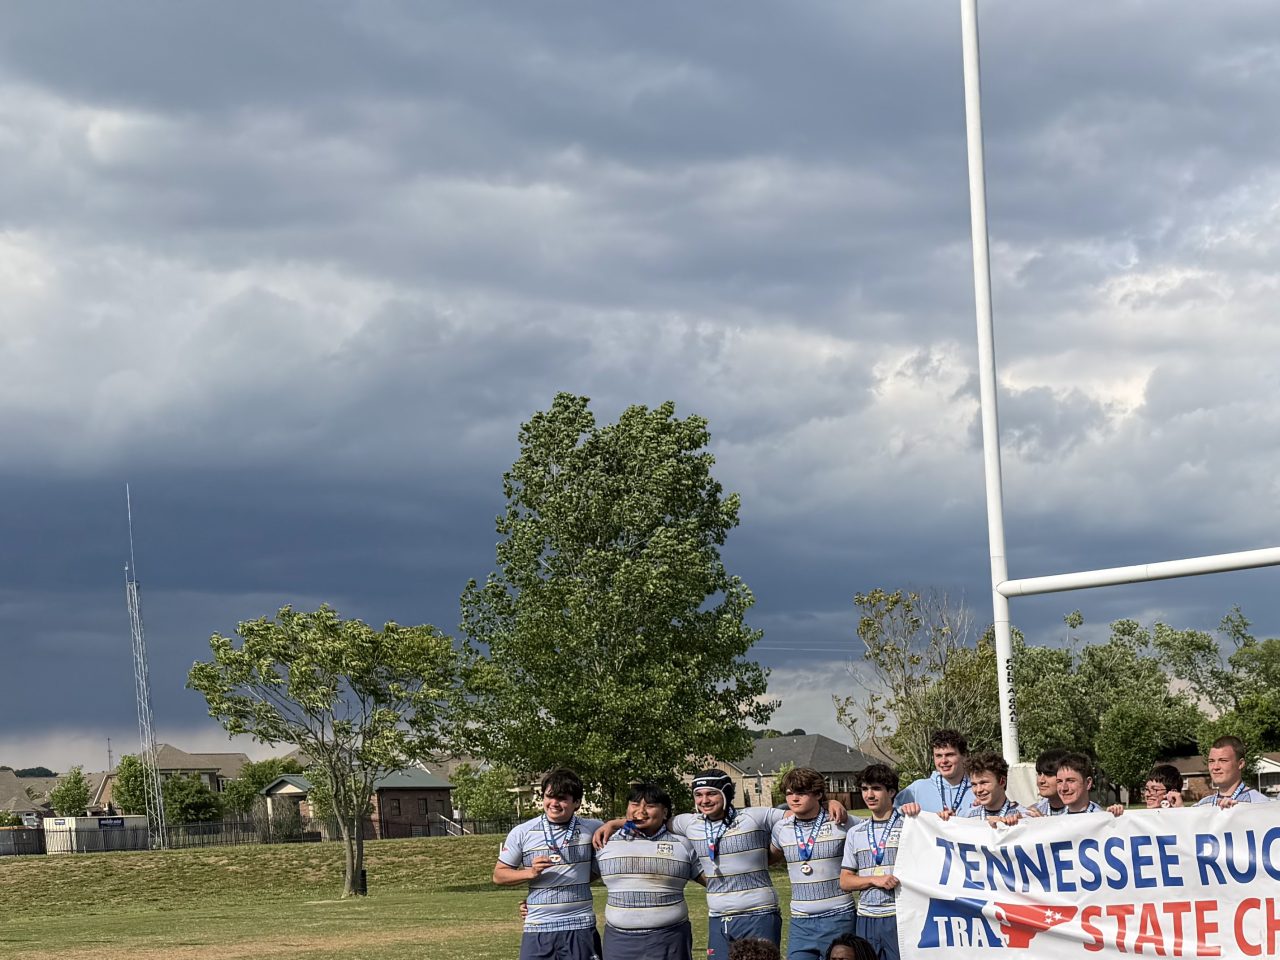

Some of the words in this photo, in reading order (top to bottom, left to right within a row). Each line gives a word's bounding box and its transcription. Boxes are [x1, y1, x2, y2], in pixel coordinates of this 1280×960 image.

[936, 835, 1184, 893] TENNESSEE
[933, 916, 990, 948] TRA
[1081, 900, 1221, 957] STATE
